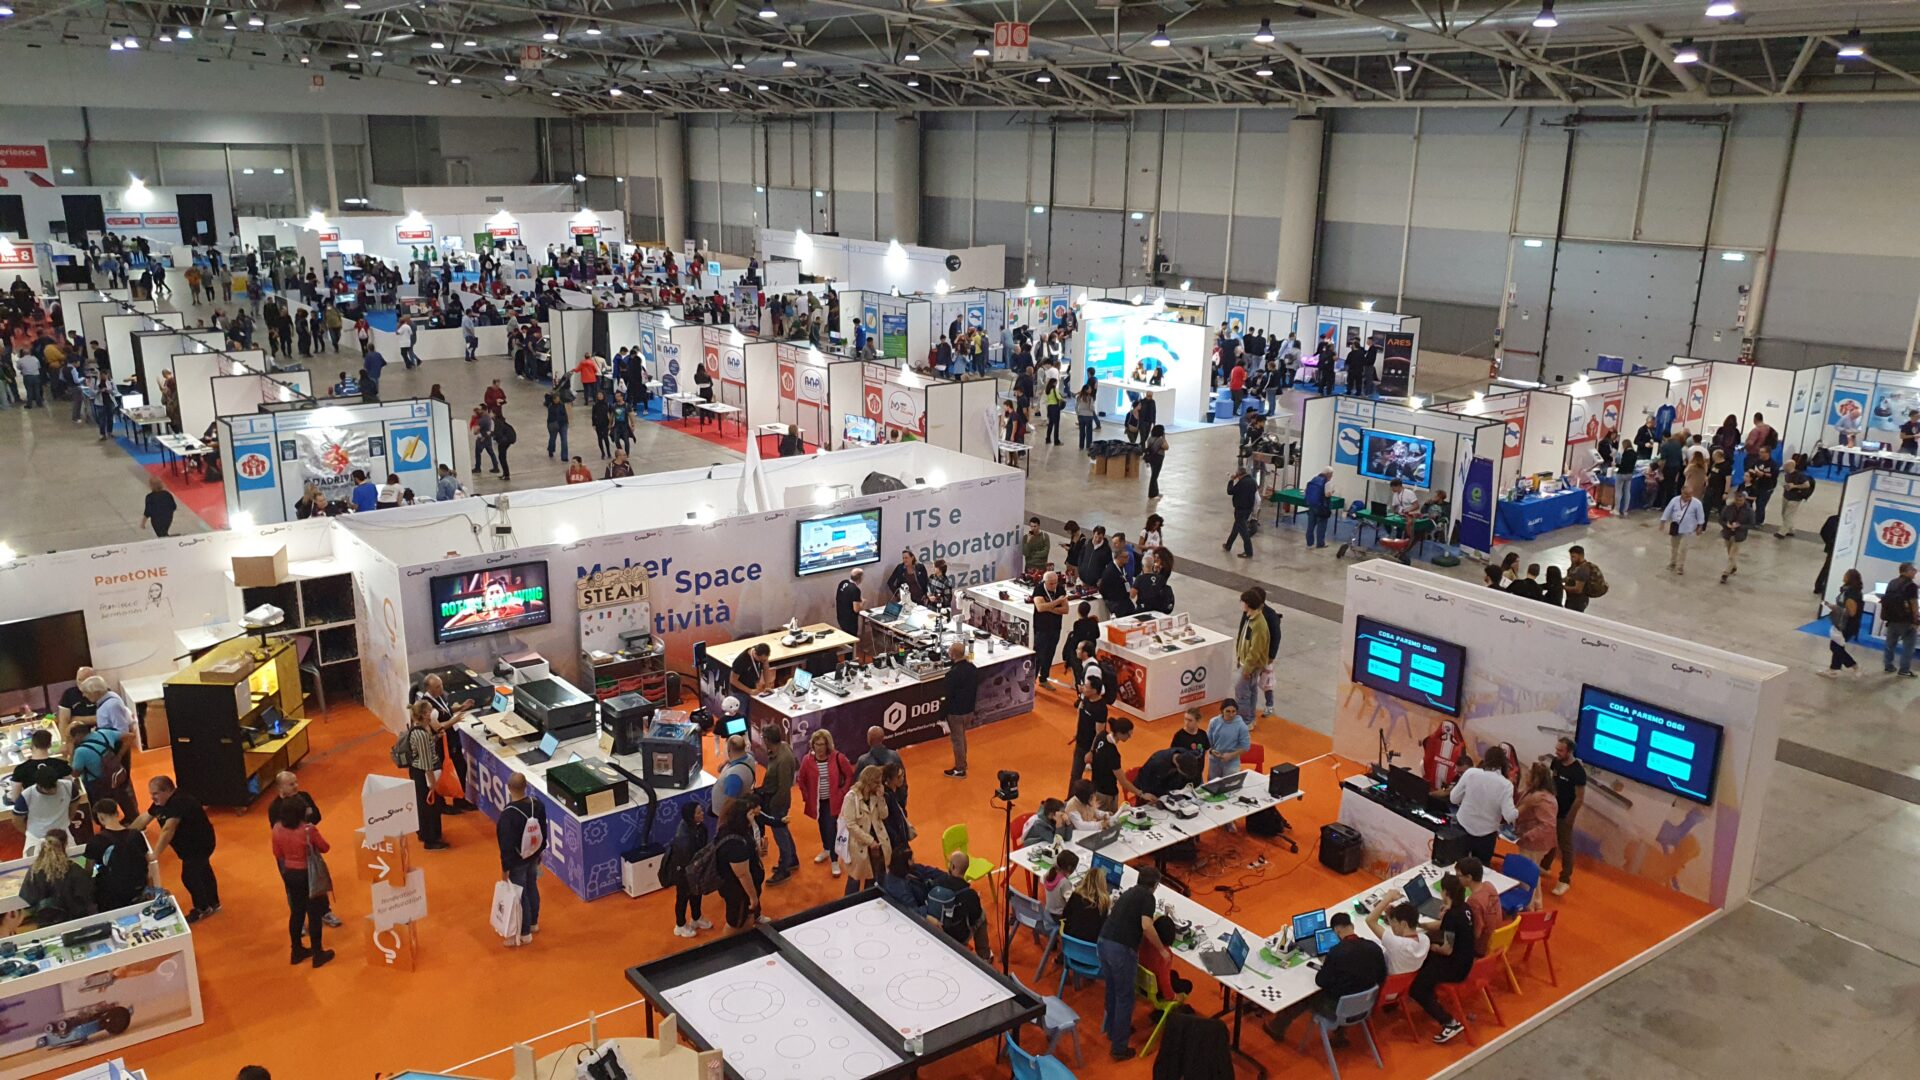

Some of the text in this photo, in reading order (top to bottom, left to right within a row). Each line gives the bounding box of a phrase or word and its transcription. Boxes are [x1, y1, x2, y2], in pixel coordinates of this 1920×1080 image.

[21, 250, 30, 261] 8
[1386, 337, 1411, 347] ARES
[304, 471, 372, 487] QUADRIVIM
[905, 507, 962, 533] ITS e
[905, 524, 1021, 564] aboratori
[94, 566, 168, 587] ParetONE
[577, 556, 762, 596] Mker Space
[949, 561, 996, 590] nzati
[583, 583, 644, 605] STEAM
[654, 599, 731, 635] tività
[1378, 630, 1395, 640] COSA
[1422, 643, 1437, 653] OGGI
[911, 700, 940, 718] DOB
[1609, 702, 1630, 715] COSA
[1666, 719, 1685, 732] OGGI
[367, 806, 404, 825] CampuStore
